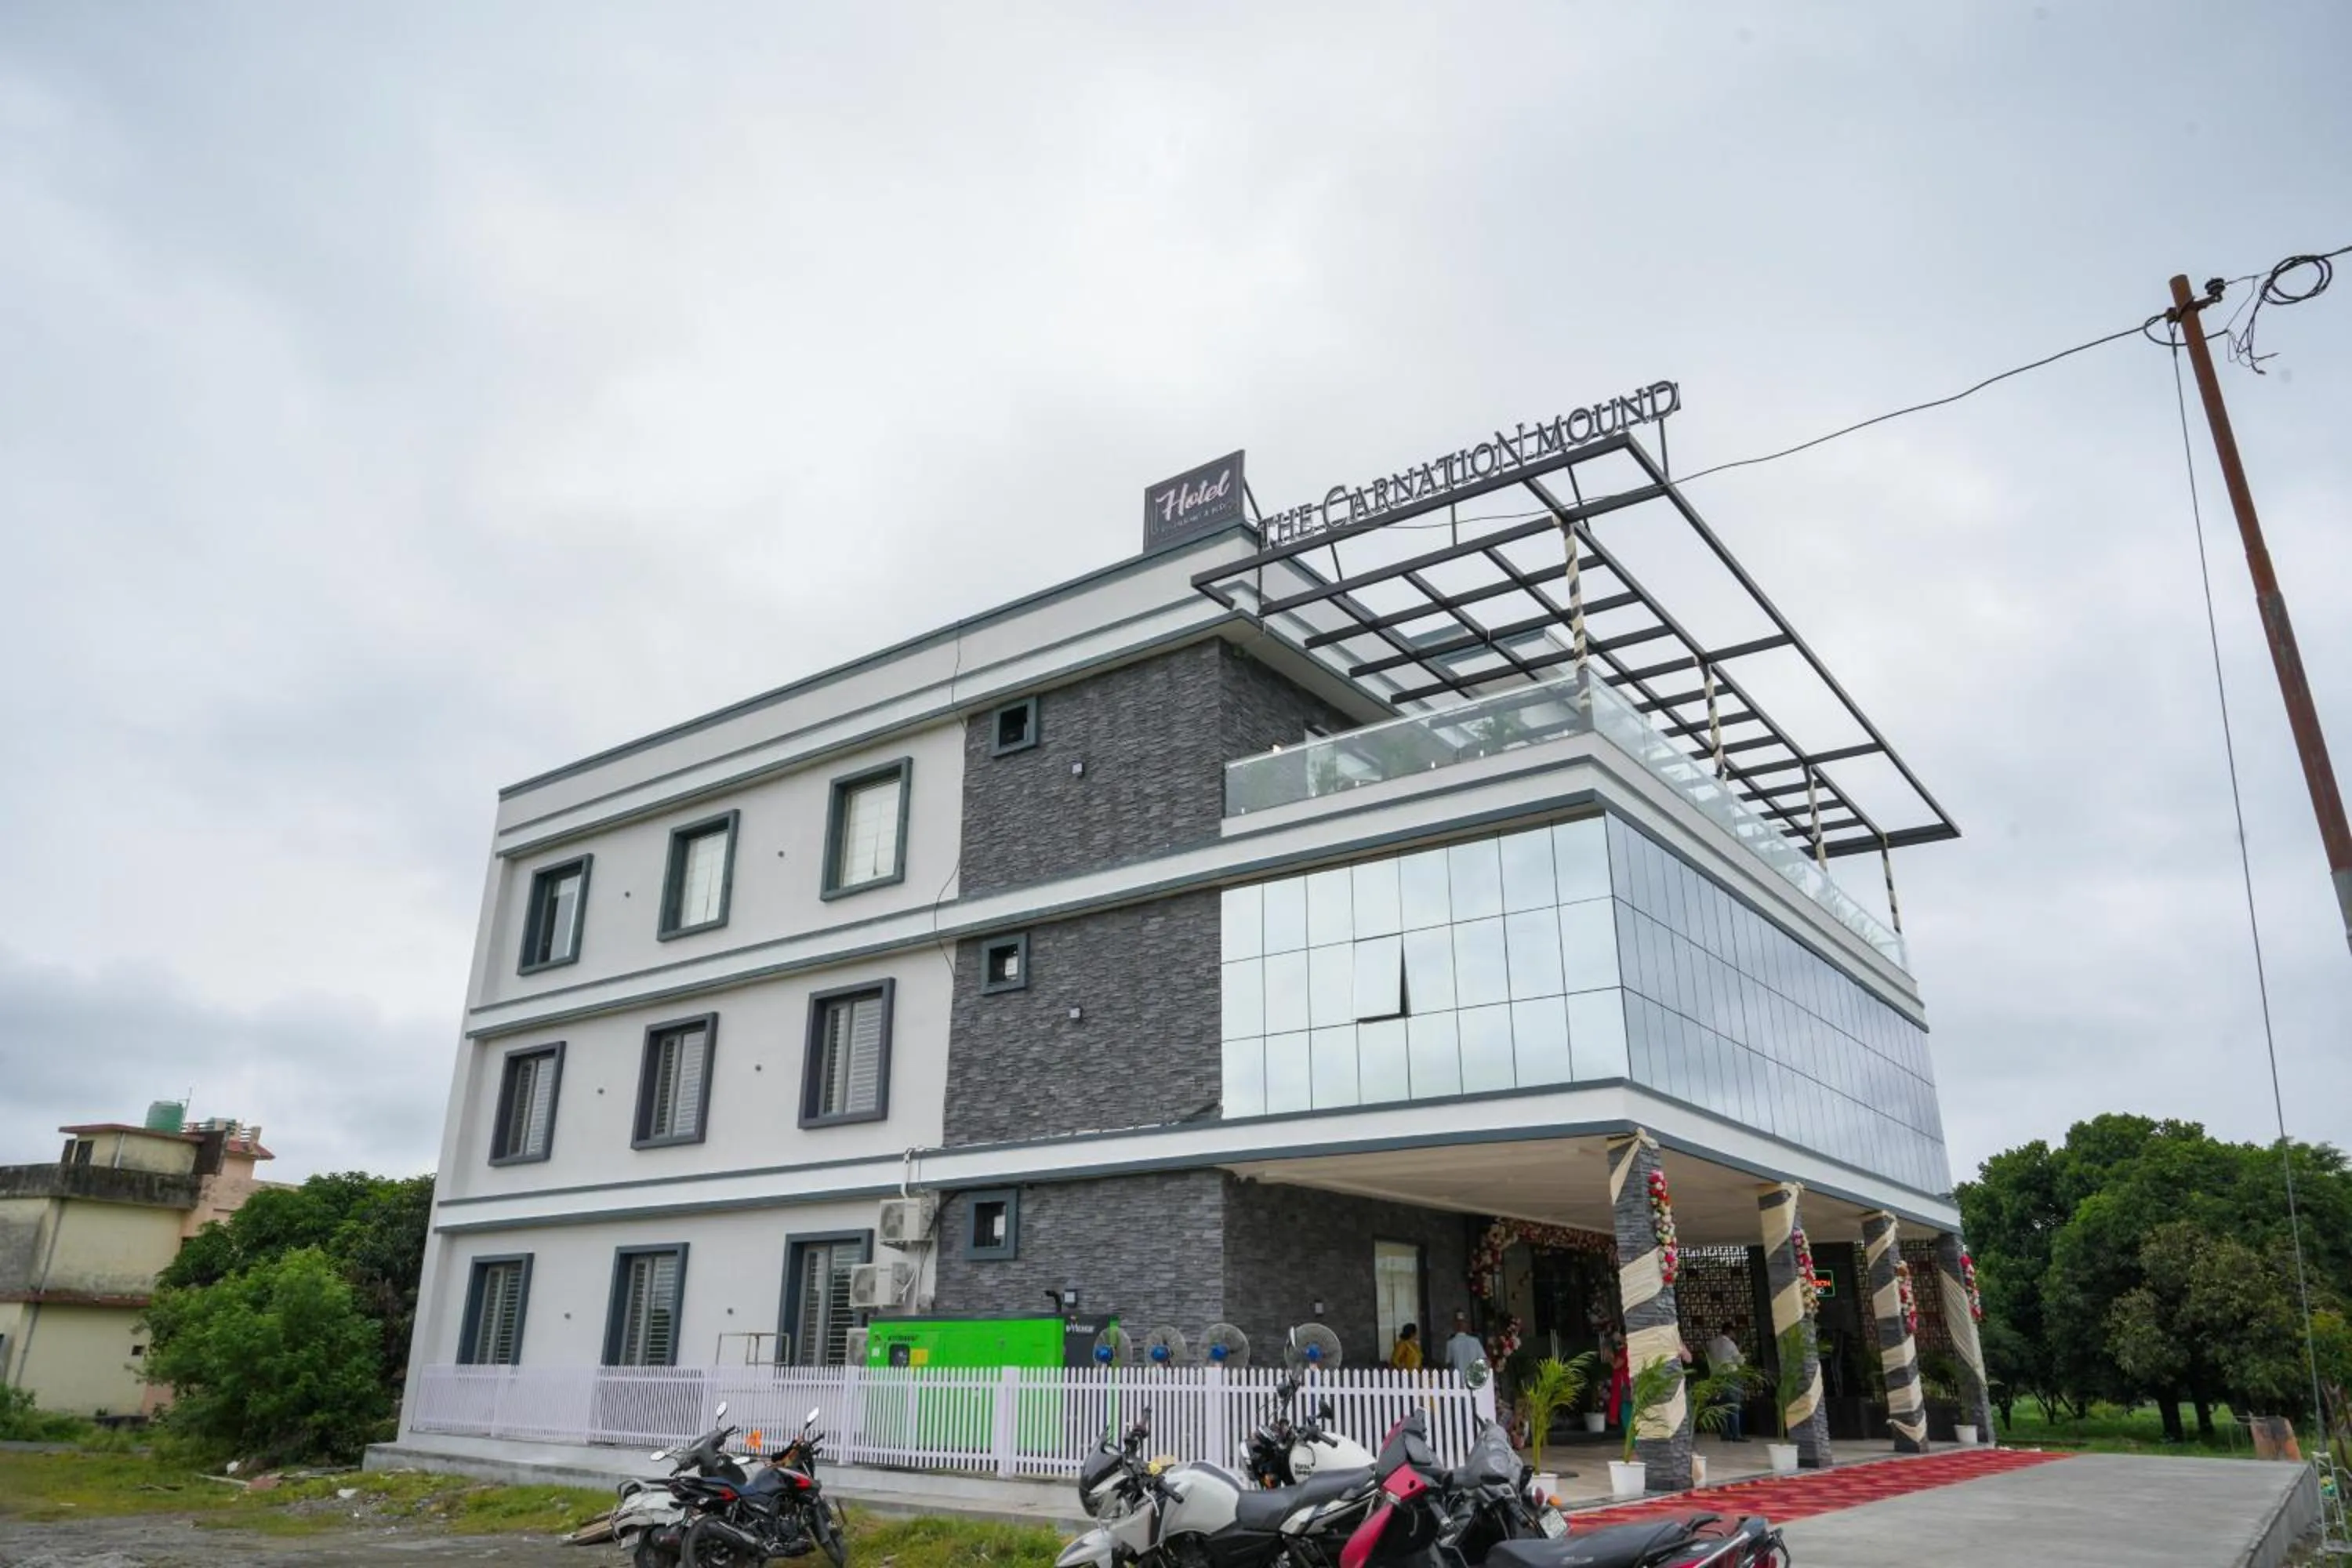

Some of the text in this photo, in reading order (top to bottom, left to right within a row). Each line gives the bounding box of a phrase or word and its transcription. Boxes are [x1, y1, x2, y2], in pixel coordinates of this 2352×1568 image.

[1156, 470, 1231, 521] Hotel
[1257, 380, 1679, 550] THE CARNATION MOUND
